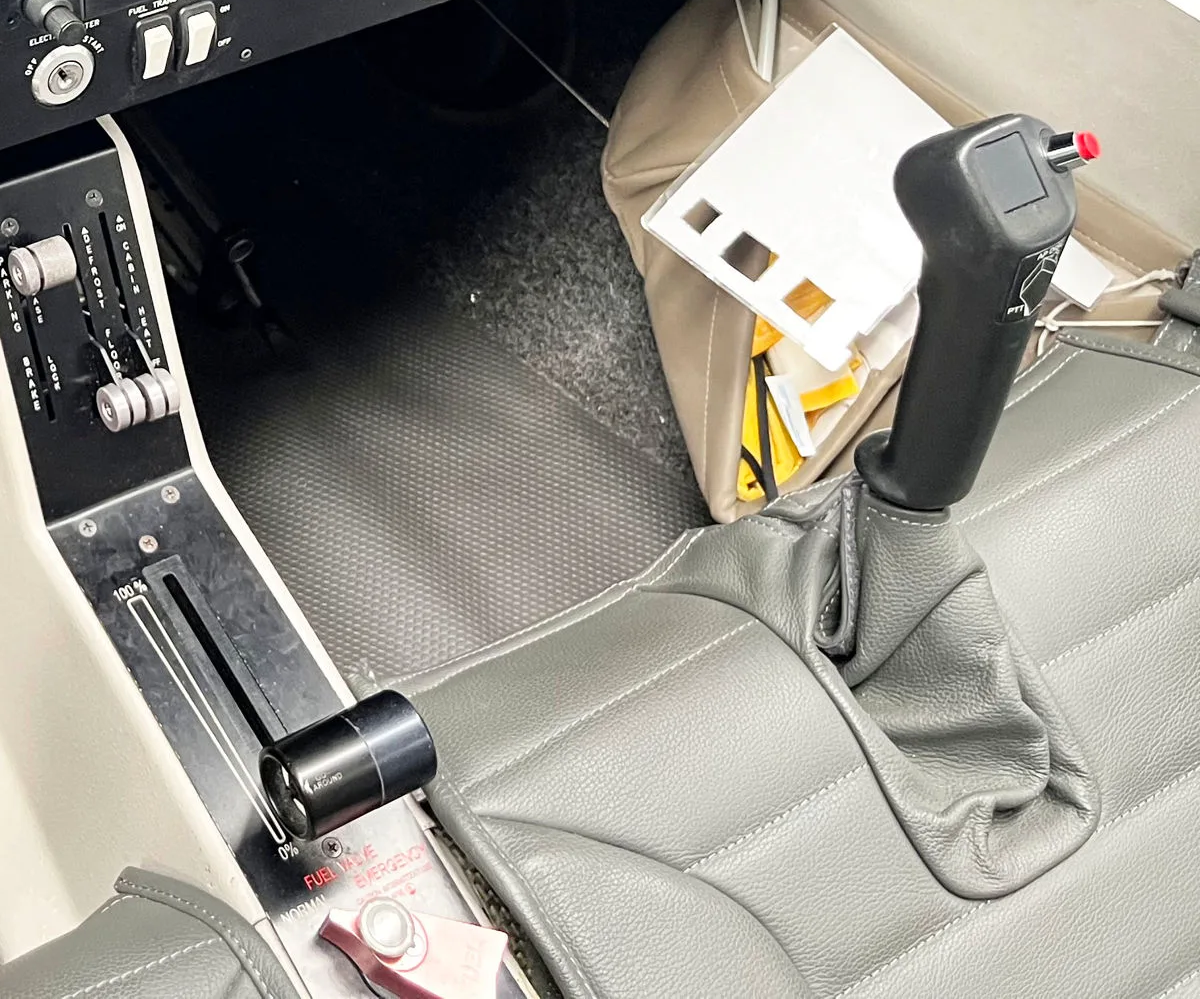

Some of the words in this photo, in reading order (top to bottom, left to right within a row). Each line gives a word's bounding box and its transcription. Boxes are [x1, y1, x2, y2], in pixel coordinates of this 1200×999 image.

[128, 5, 148, 17] FUEL
[82, 35, 105, 54] START
[83, 234, 105, 309] DEFROST
[116, 223, 126, 232] ON
[122, 241, 140, 294] CABIN
[138, 306, 153, 348] HEAT
[1007, 304, 1024, 315] PTT
[22, 356, 41, 411] BRAKE
[47, 355, 61, 391] LOCK
[312, 772, 343, 792] AROUND
[278, 842, 299, 861] 0%
[303, 865, 339, 890] FUEL
[335, 844, 378, 872] VALVE
[353, 842, 427, 888] EMERGENCY
